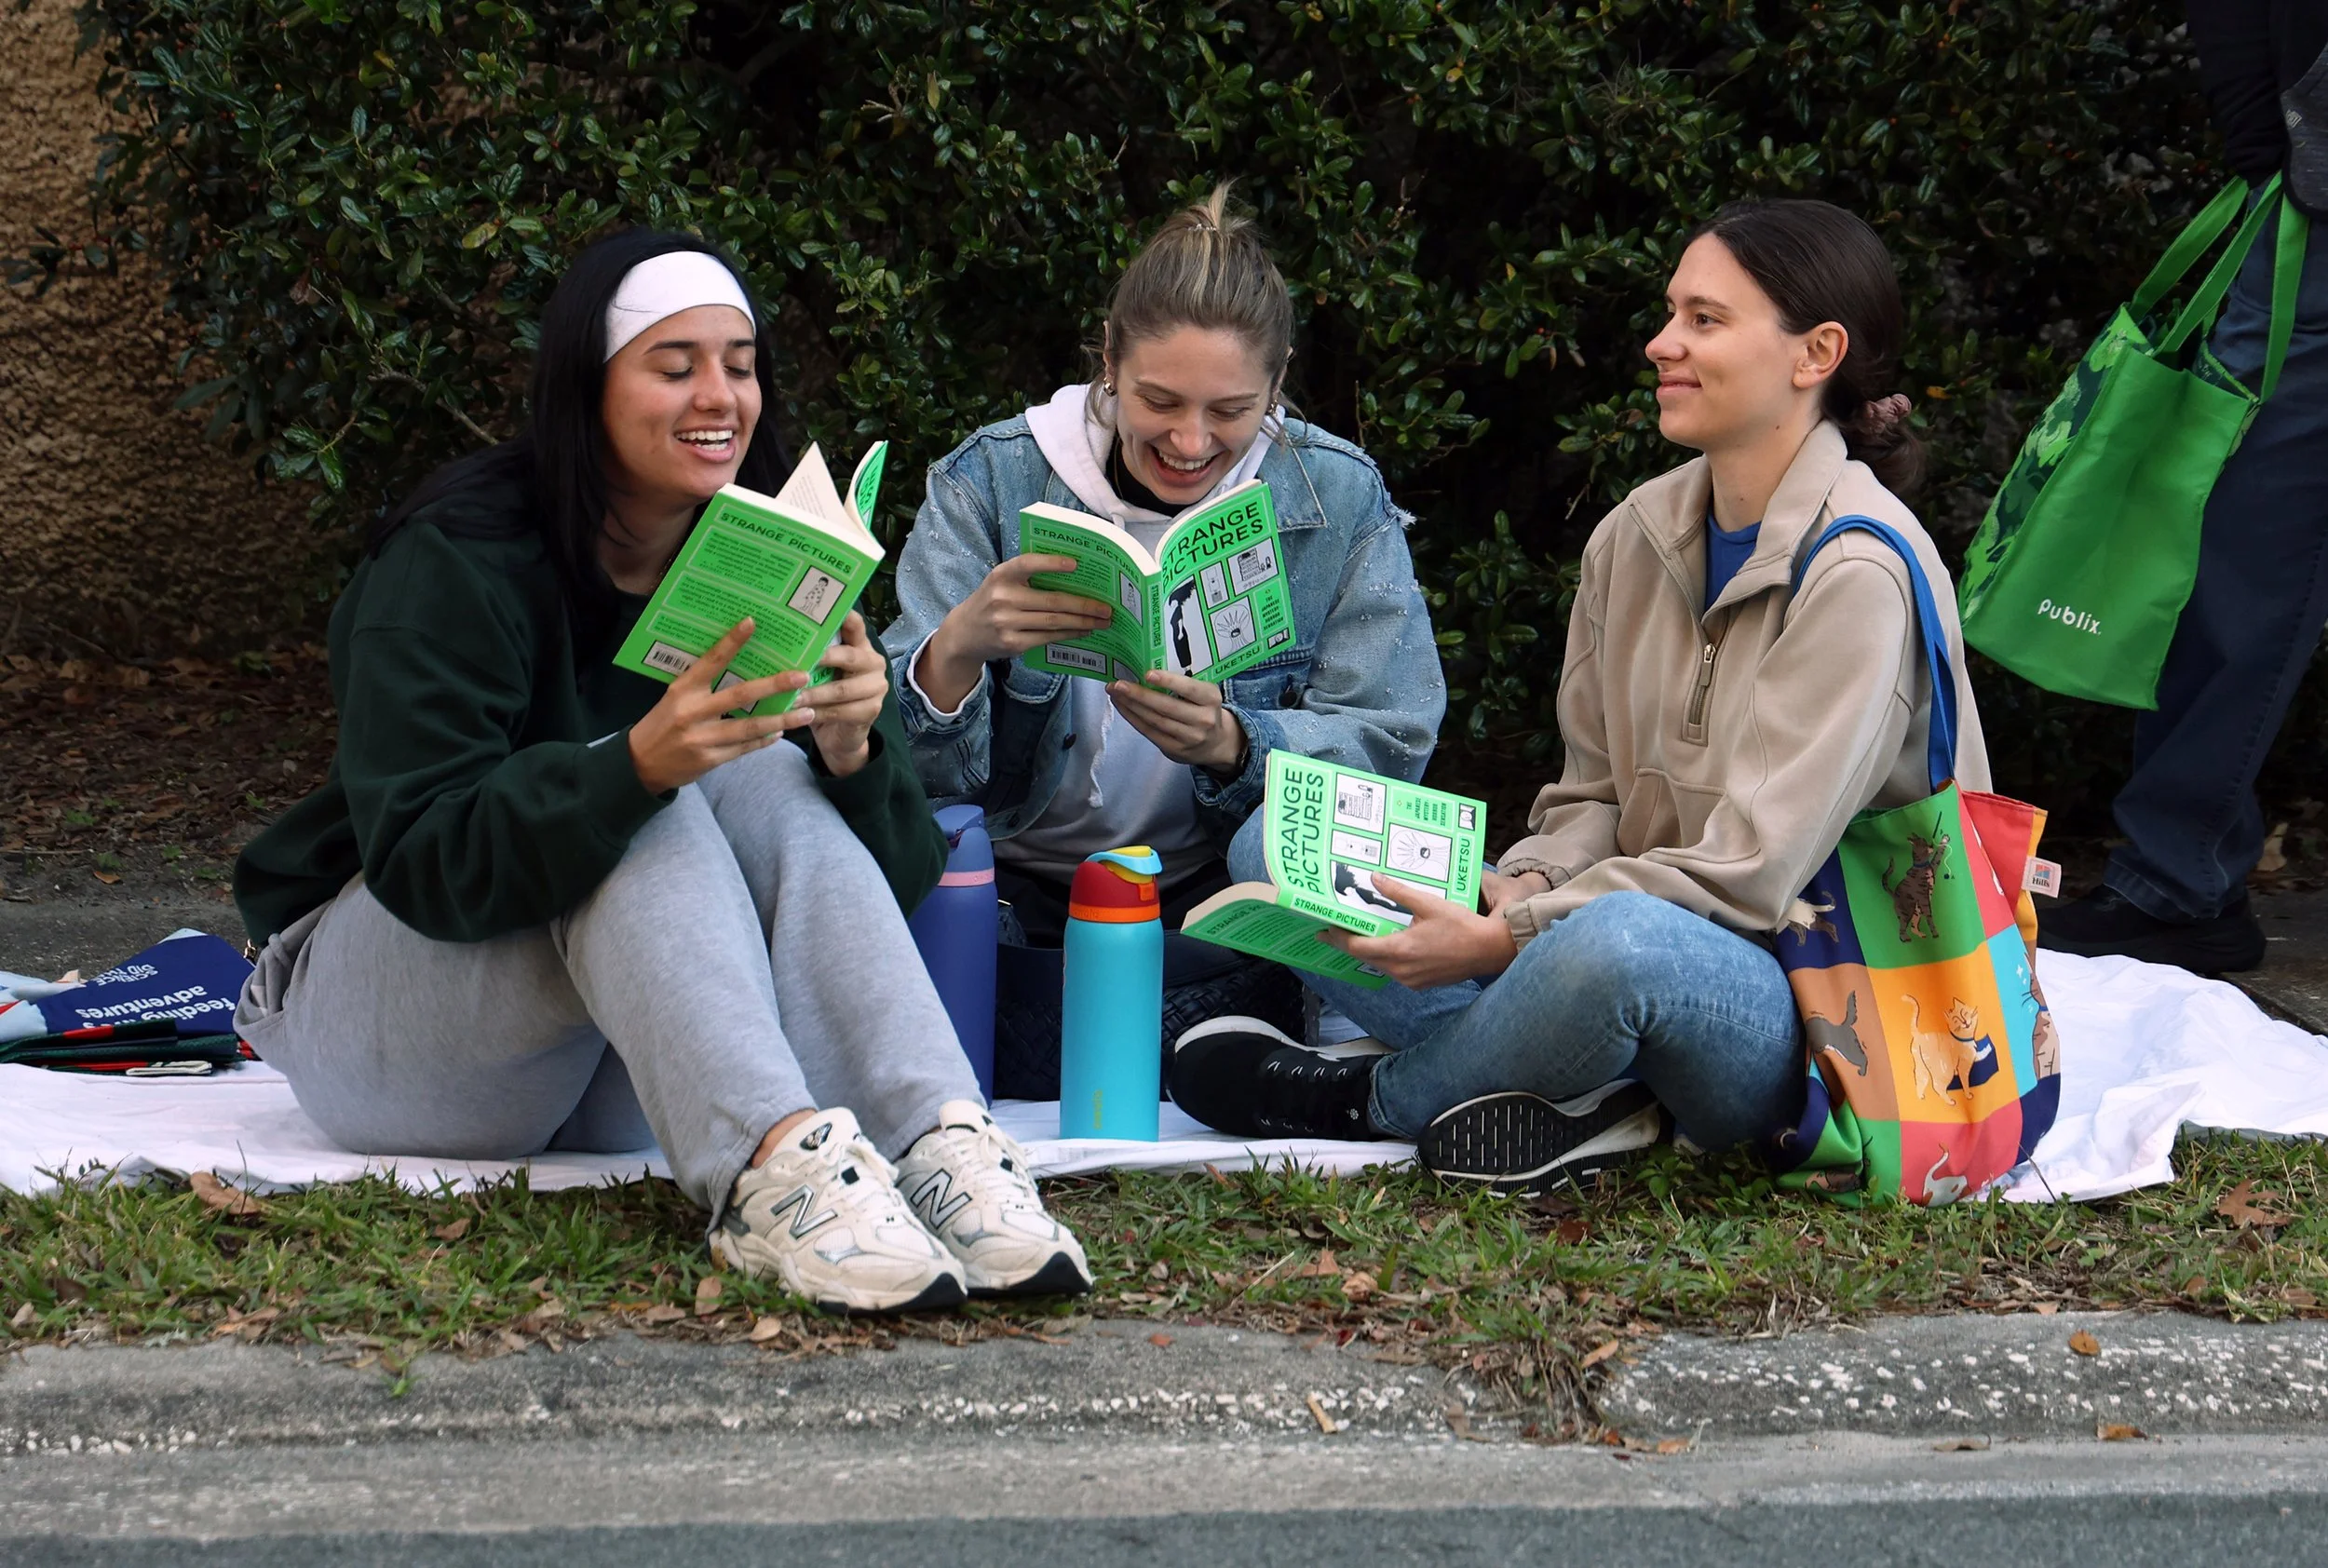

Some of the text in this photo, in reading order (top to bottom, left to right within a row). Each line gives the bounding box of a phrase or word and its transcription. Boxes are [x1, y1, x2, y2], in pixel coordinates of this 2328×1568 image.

[721, 512, 784, 542] STRANGE
[788, 538, 852, 574] PICTURES
[1033, 527, 1090, 548] STRANGE
[1162, 519, 1264, 594] PICTURES
[1151, 584, 1162, 647] STRANGE PICTURES
[1214, 646, 1262, 675] UKETSU
[1280, 767, 1305, 888] STRANGE
[1302, 772, 1325, 896] PICTURES
[1456, 838, 1470, 892] UKETSU
[1294, 898, 1334, 918] STRANGE
[1335, 912, 1376, 933] PICTURES
[75, 985, 208, 1019] adventures
